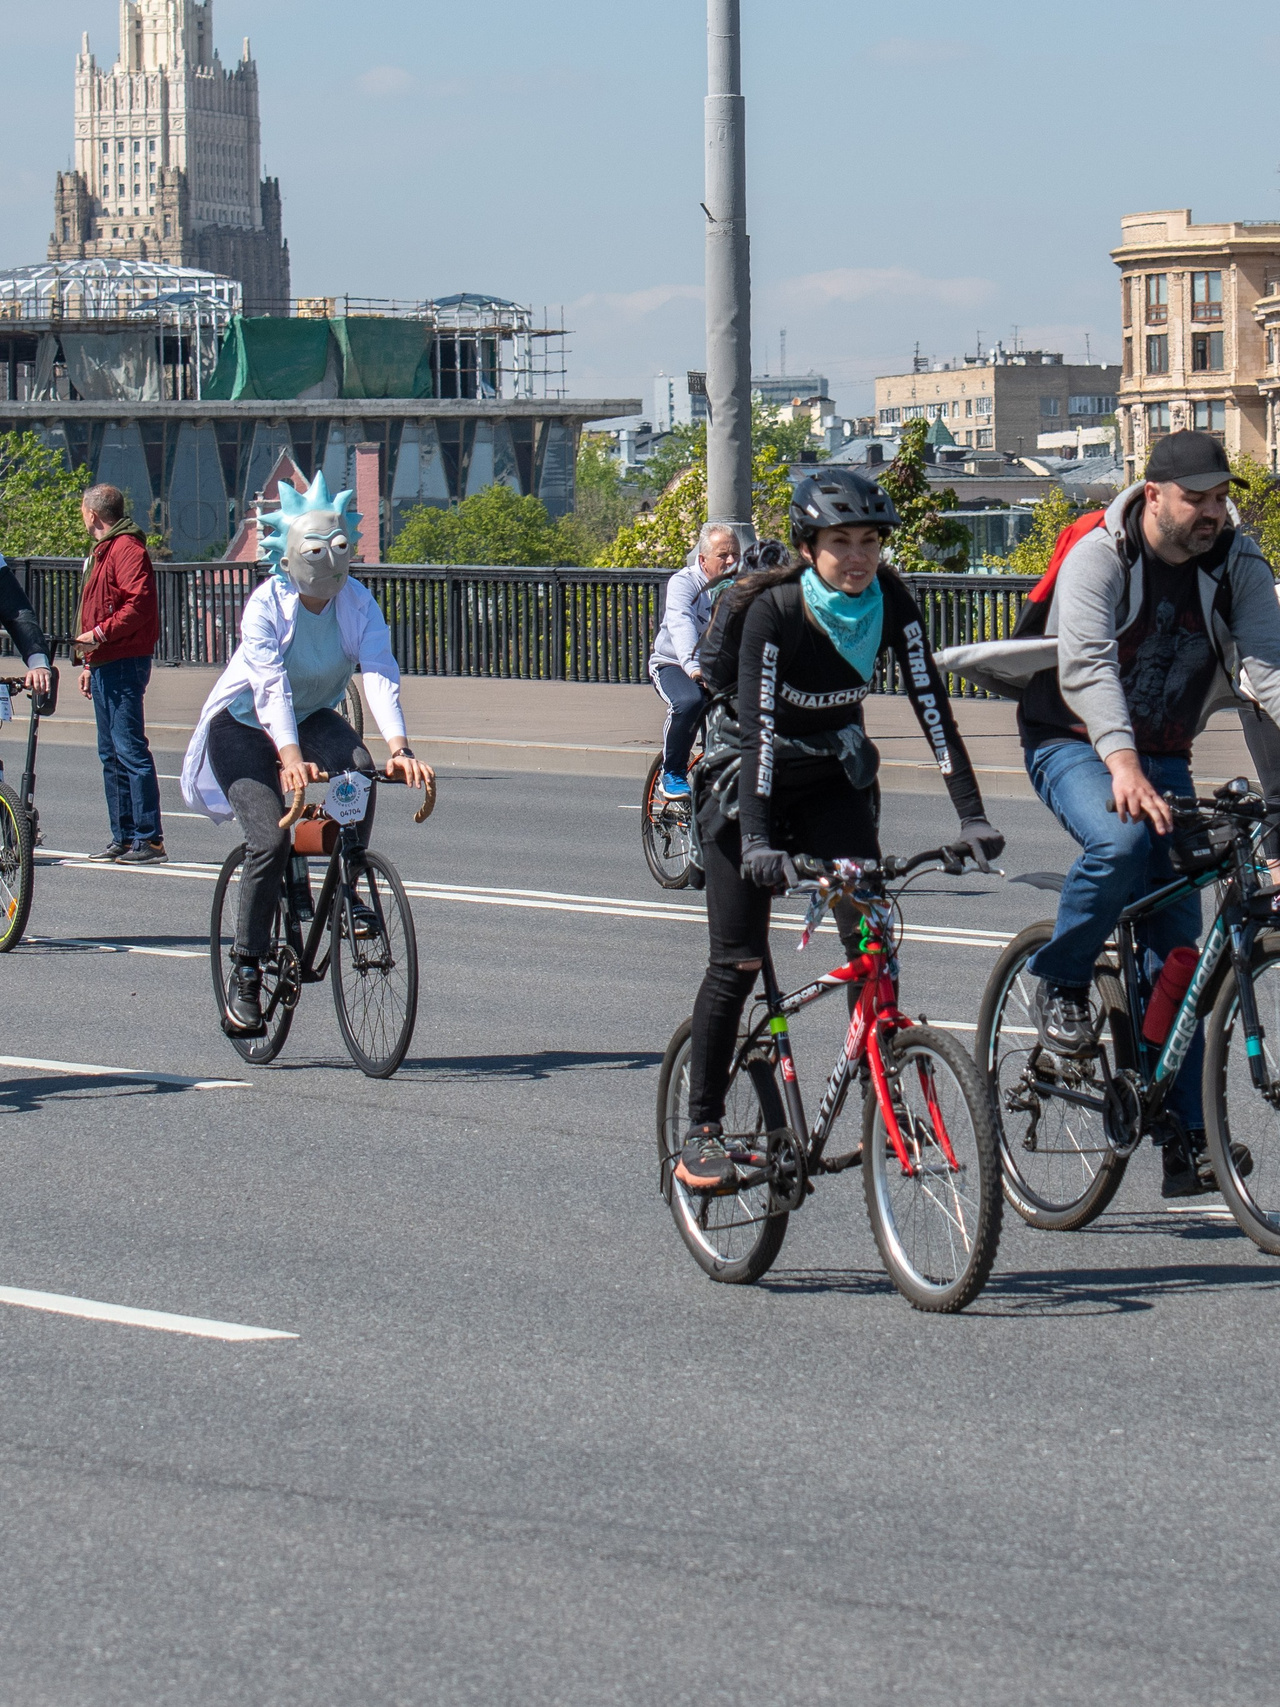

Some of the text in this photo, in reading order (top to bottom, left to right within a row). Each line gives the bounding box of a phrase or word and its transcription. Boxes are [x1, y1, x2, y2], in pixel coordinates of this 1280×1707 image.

[757, 642, 780, 798] EXTRA POWER
[903, 620, 954, 775] EXTRA POWER
[339, 808, 361, 818] 04704
[779, 984, 819, 1011] DEFENDER
[1162, 928, 1224, 1070] FORWARD
